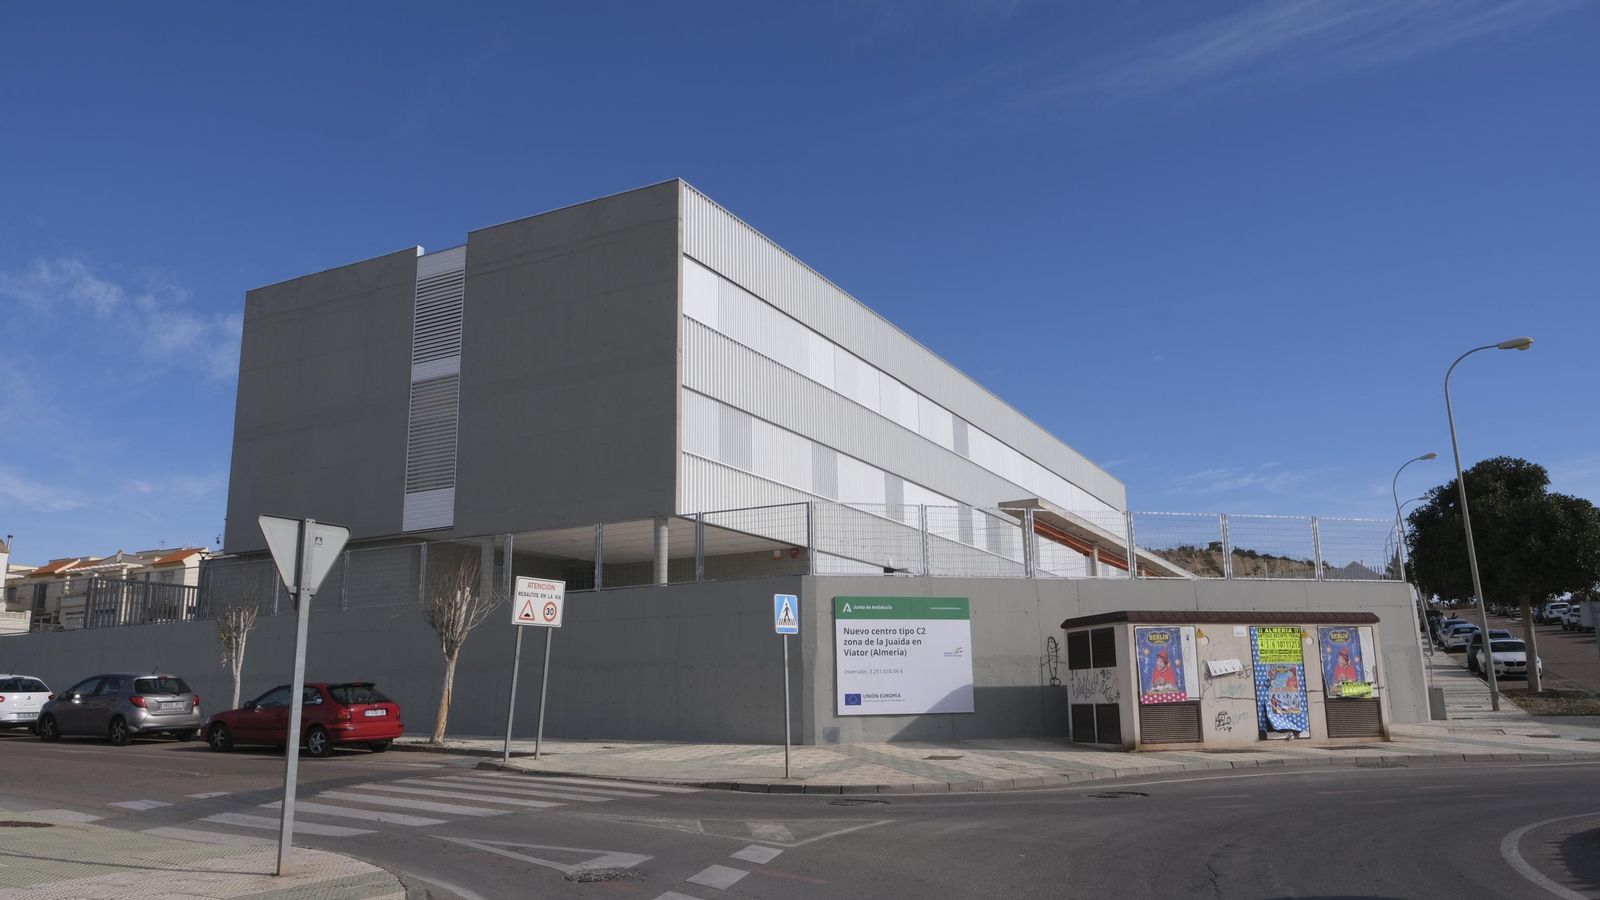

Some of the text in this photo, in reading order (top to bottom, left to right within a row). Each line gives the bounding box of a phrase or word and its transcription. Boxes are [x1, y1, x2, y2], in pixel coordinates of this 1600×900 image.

[546, 607, 554, 616] 30
[843, 627, 869, 635] Nuevo
[899, 627, 915, 636] tipo
[916, 627, 926, 635] C2
[1330, 632, 1349, 640] BERLIN
[1149, 633, 1169, 641] BERLIN
[865, 638, 875, 646] de
[876, 638, 883, 646] la
[885, 638, 910, 647] Juaida
[843, 648, 907, 657] Viator (Almería)
